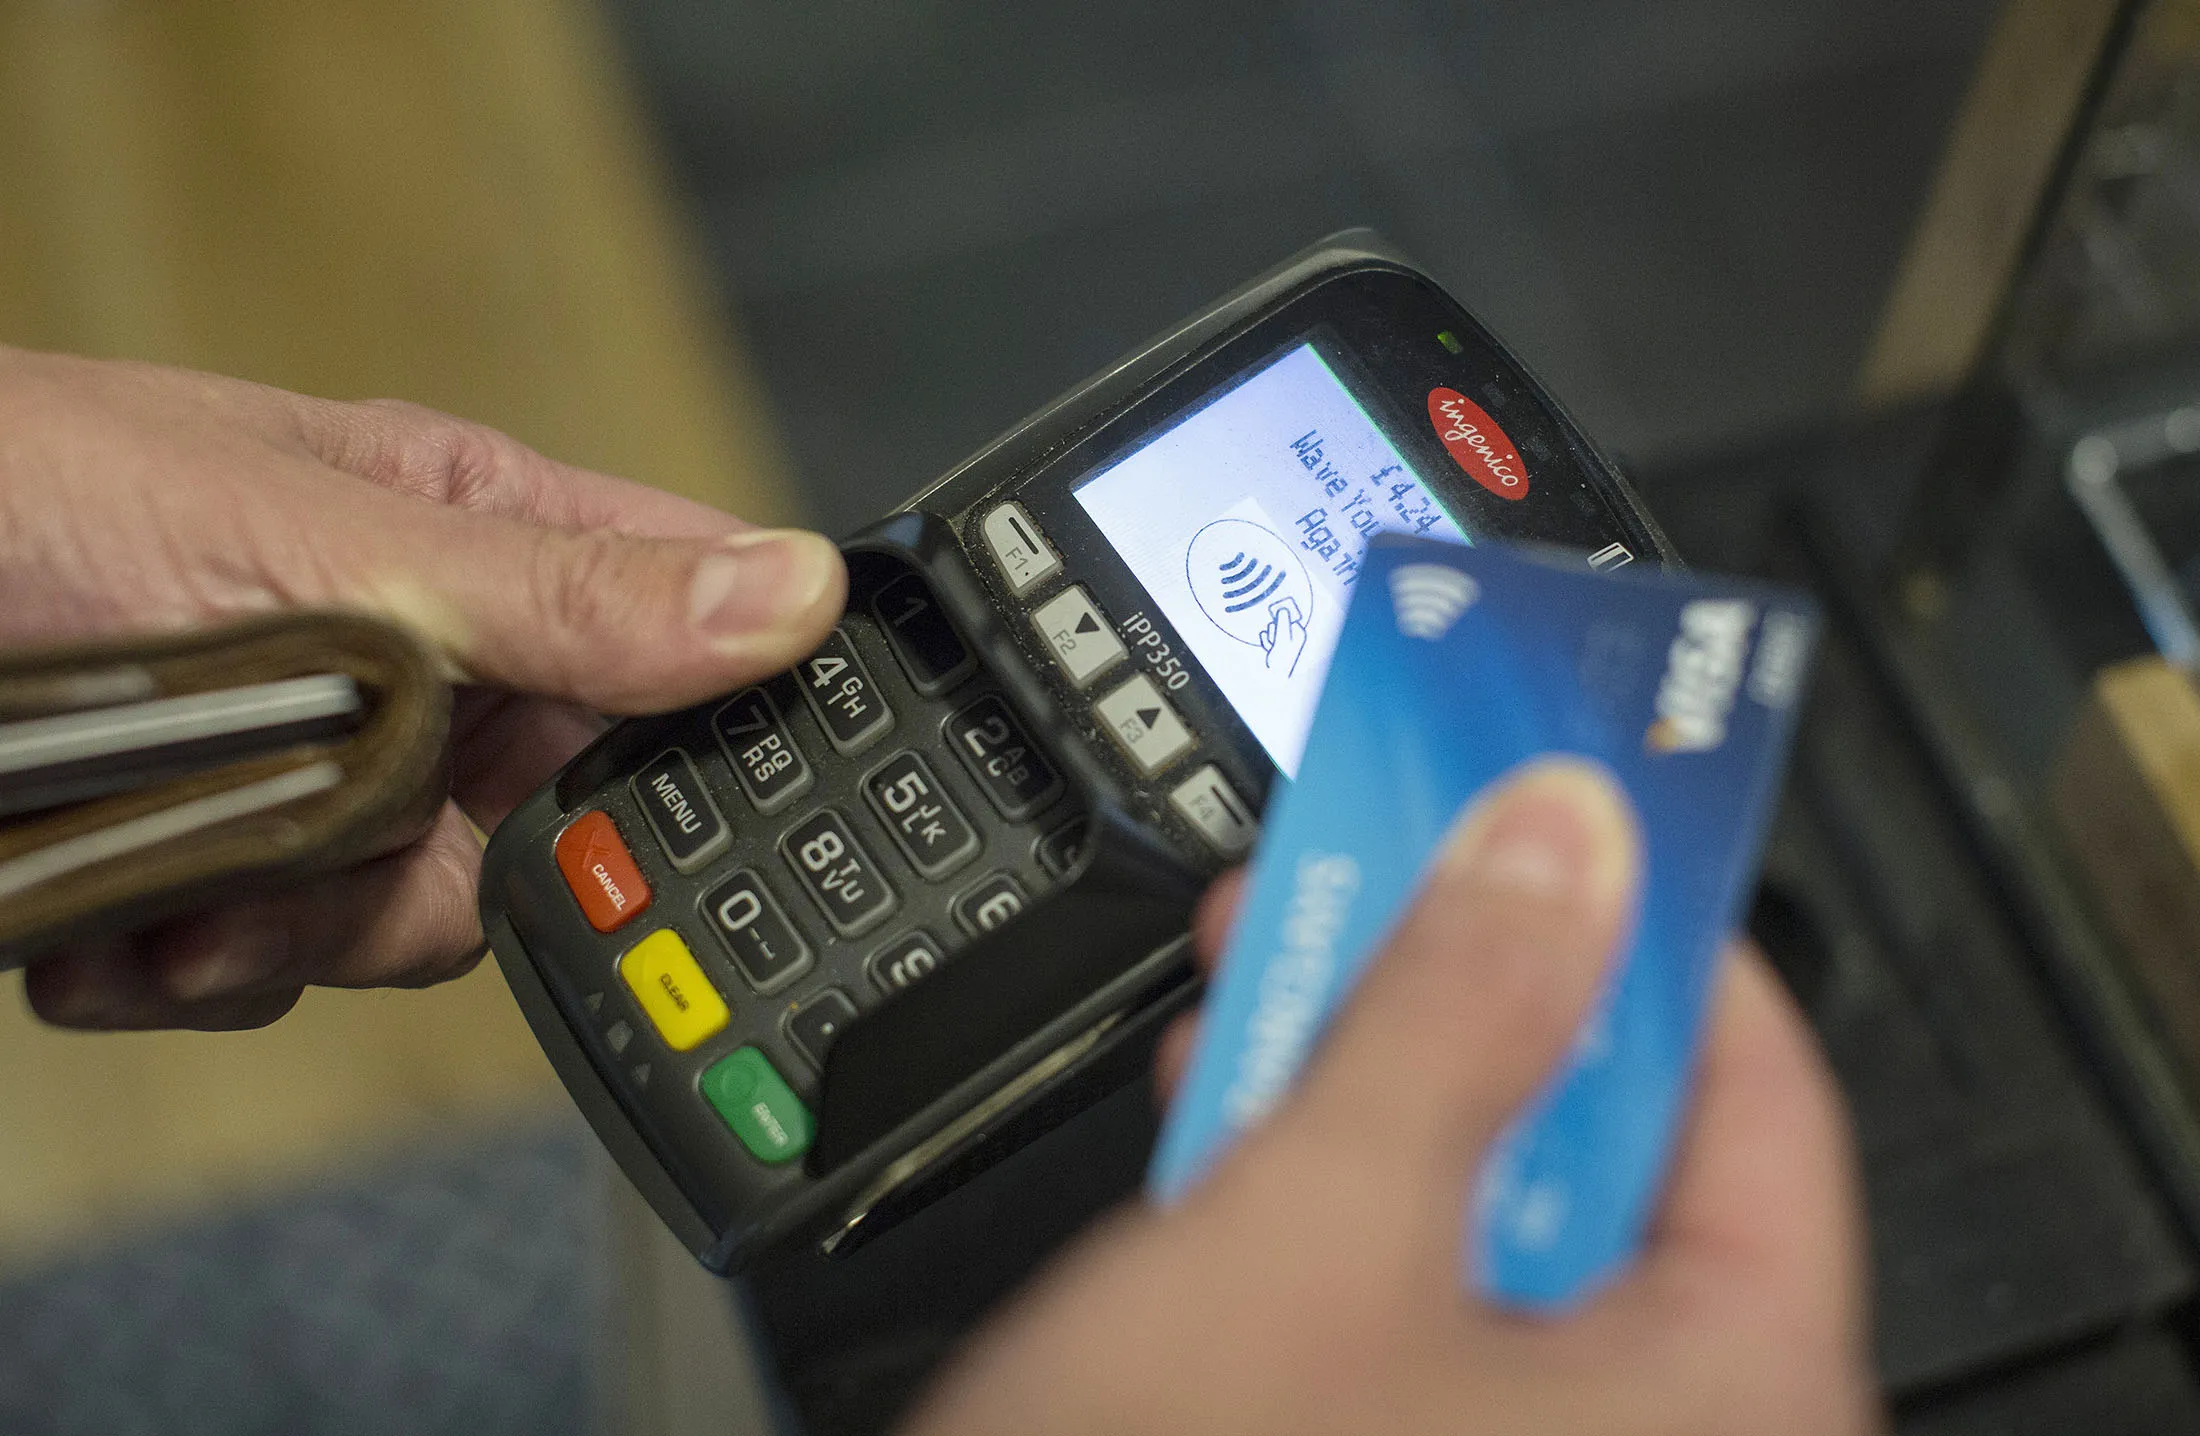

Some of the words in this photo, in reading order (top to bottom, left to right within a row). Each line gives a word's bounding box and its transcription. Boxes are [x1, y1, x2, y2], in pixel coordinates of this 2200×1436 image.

[1439, 398, 1518, 487] ingenico
[1289, 429, 1348, 498] Wave
[1341, 488, 1385, 538] You
[1369, 463, 1442, 535] £4.24
[1005, 546, 1029, 571] F1
[1295, 507, 1363, 586] Again
[893, 598, 928, 627] 1
[1052, 629, 1077, 656] F2
[1122, 611, 1190, 690] iPP350
[809, 657, 849, 688] 4
[726, 704, 769, 736] 7
[963, 716, 1009, 758] 2
[1119, 718, 1145, 744] F3
[651, 772, 702, 835] MENU
[883, 771, 929, 813] 5
[800, 830, 845, 872] 8
[592, 863, 627, 912] CANCEL
[718, 889, 762, 931] 0
[658, 973, 690, 1013] CLEAR
